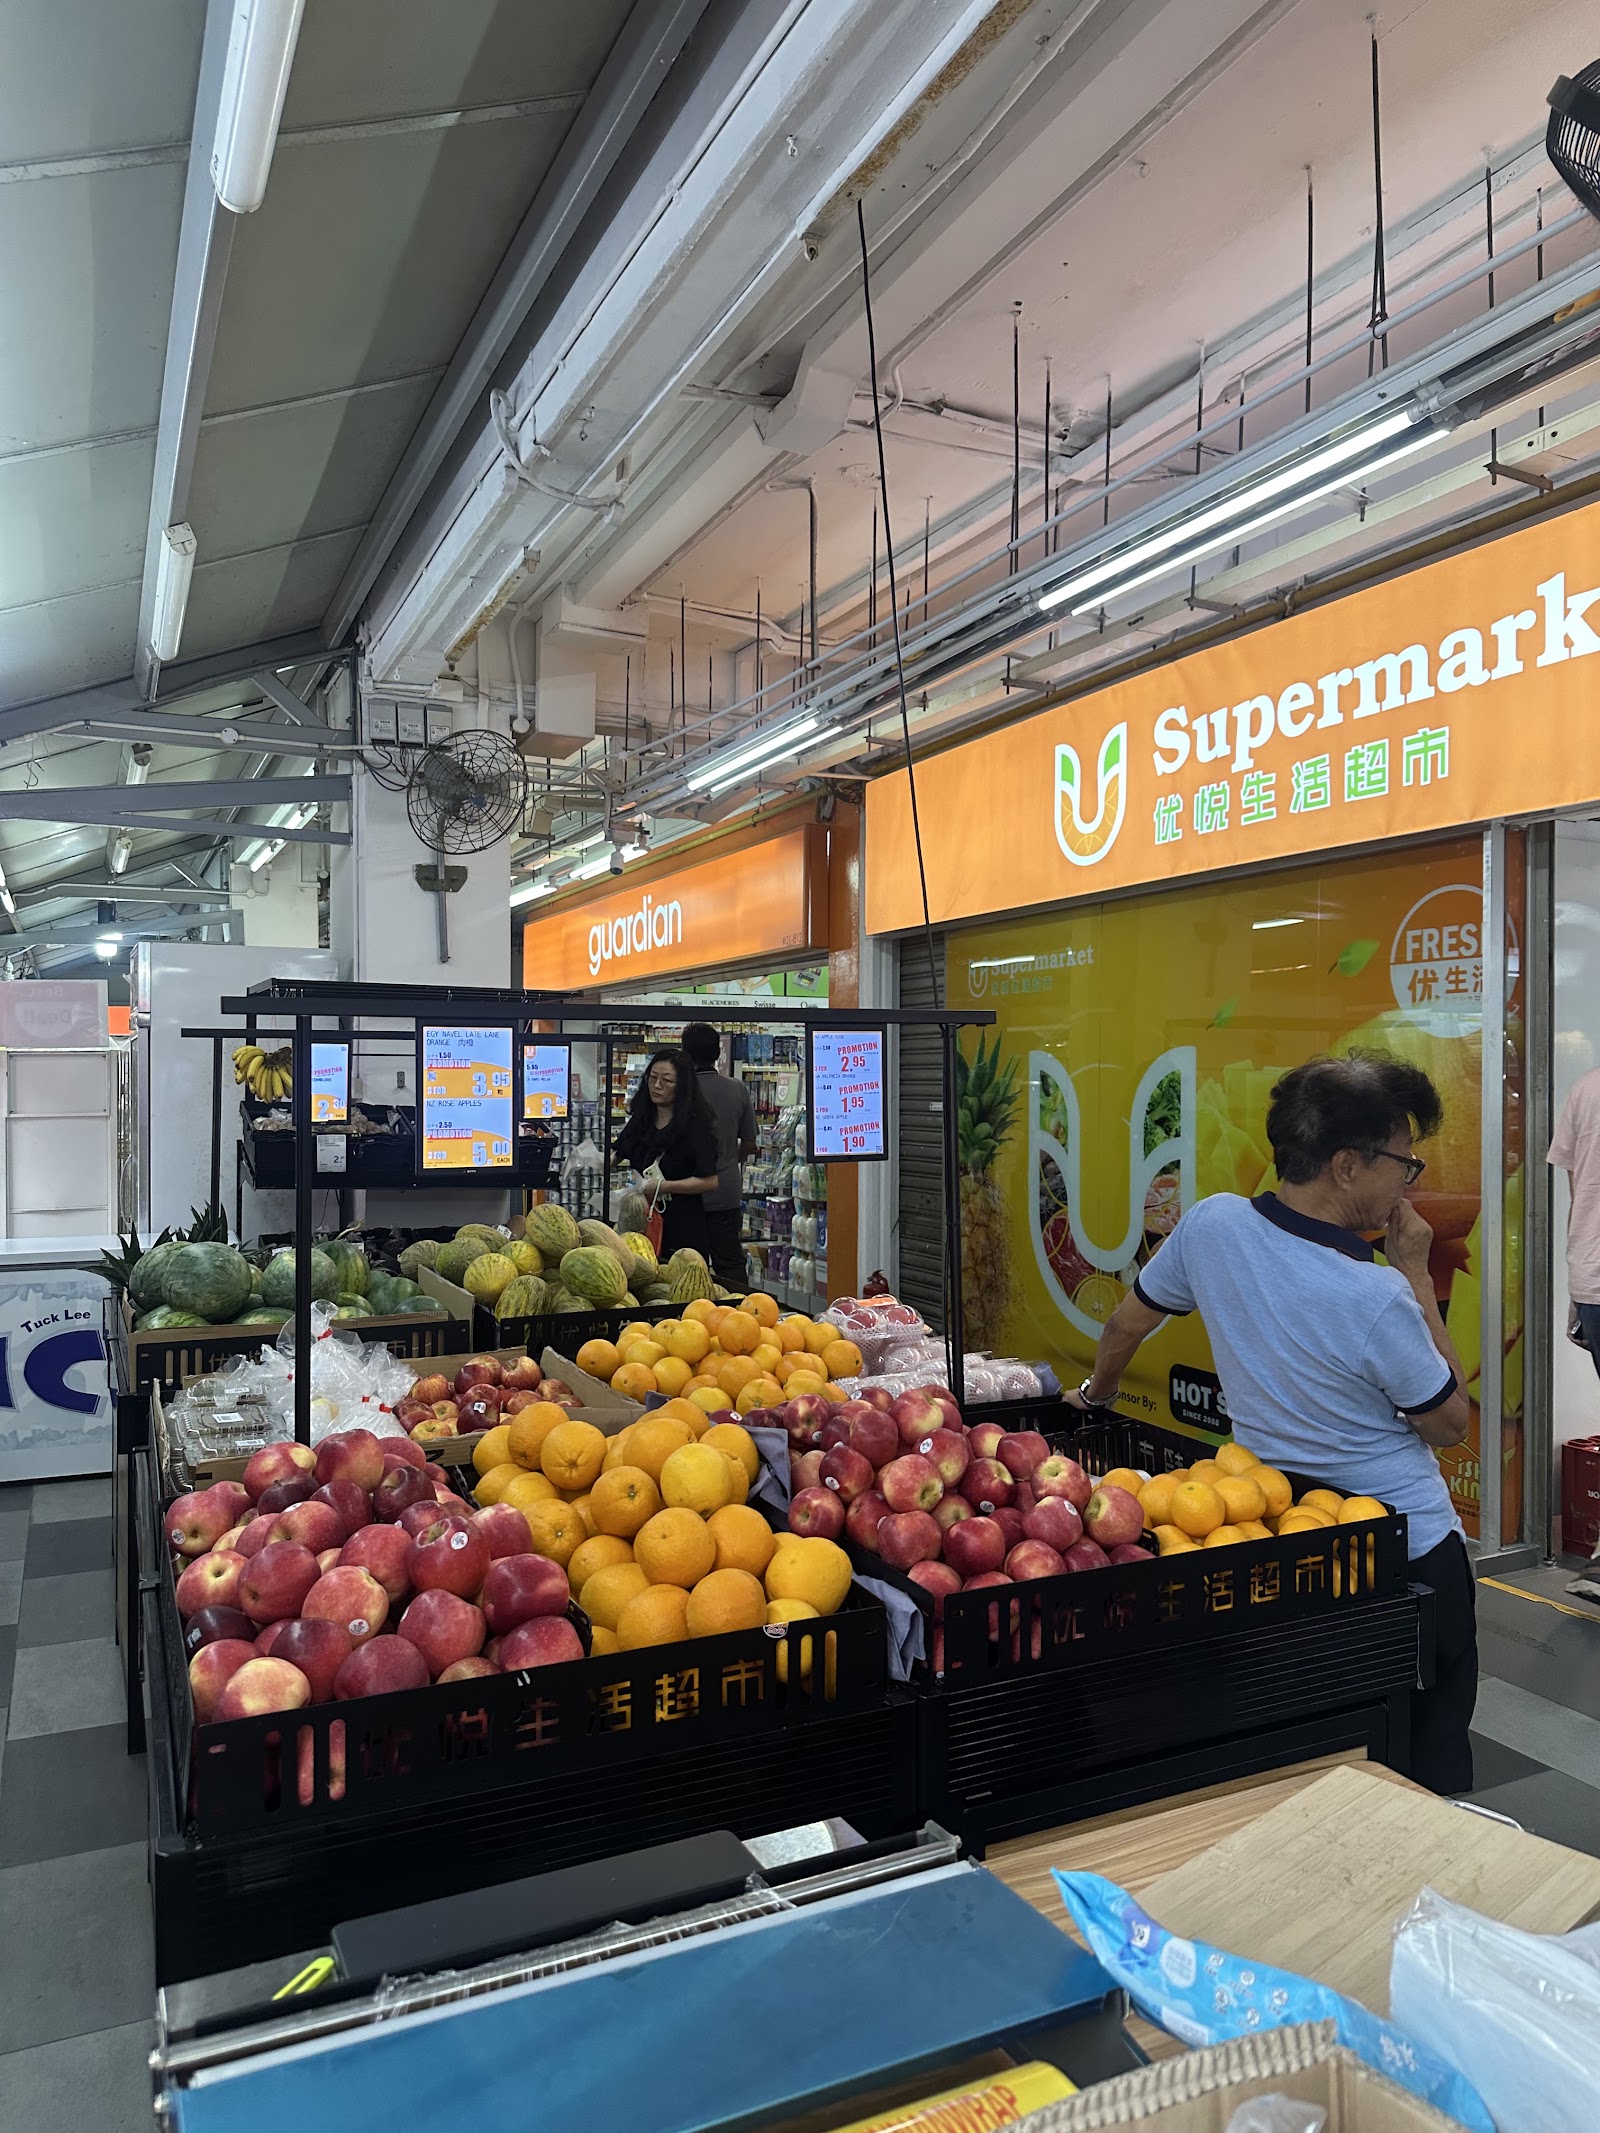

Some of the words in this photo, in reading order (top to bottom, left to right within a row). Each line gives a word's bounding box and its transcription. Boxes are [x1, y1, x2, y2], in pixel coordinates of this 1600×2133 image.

[1153, 725, 1451, 846] 优悦生活超市
[588, 894, 682, 976] guardian
[1405, 922, 1483, 962] FRES
[754, 1000, 776, 1008] Swisse
[426, 1030, 438, 1038] EGY
[442, 1030, 462, 1038] NAVEL
[837, 1041, 878, 1056] PROMOTION
[313, 1066, 343, 1077] PROMOTION
[426, 1059, 472, 1068] PROMOTION
[841, 1055, 866, 1072] 2.95
[433, 1086, 447, 1095] FOR
[472, 1071, 511, 1096] 3.95
[839, 1081, 880, 1096] PROMOTION
[841, 1096, 864, 1113] 1.95
[427, 1128, 473, 1139] PROMOTION
[840, 1121, 880, 1136] PROMOTION
[842, 1136, 865, 1153] 1.90
[433, 1151, 447, 1160] FOR
[472, 1140, 511, 1166] 5.00
[20, 1313, 60, 1334] Tuck
[64, 1309, 91, 1321] Lee
[1172, 1377, 1212, 1410] HOT
[1142, 1395, 1157, 1412] By:
[1182, 1408, 1202, 1421] SINCE
